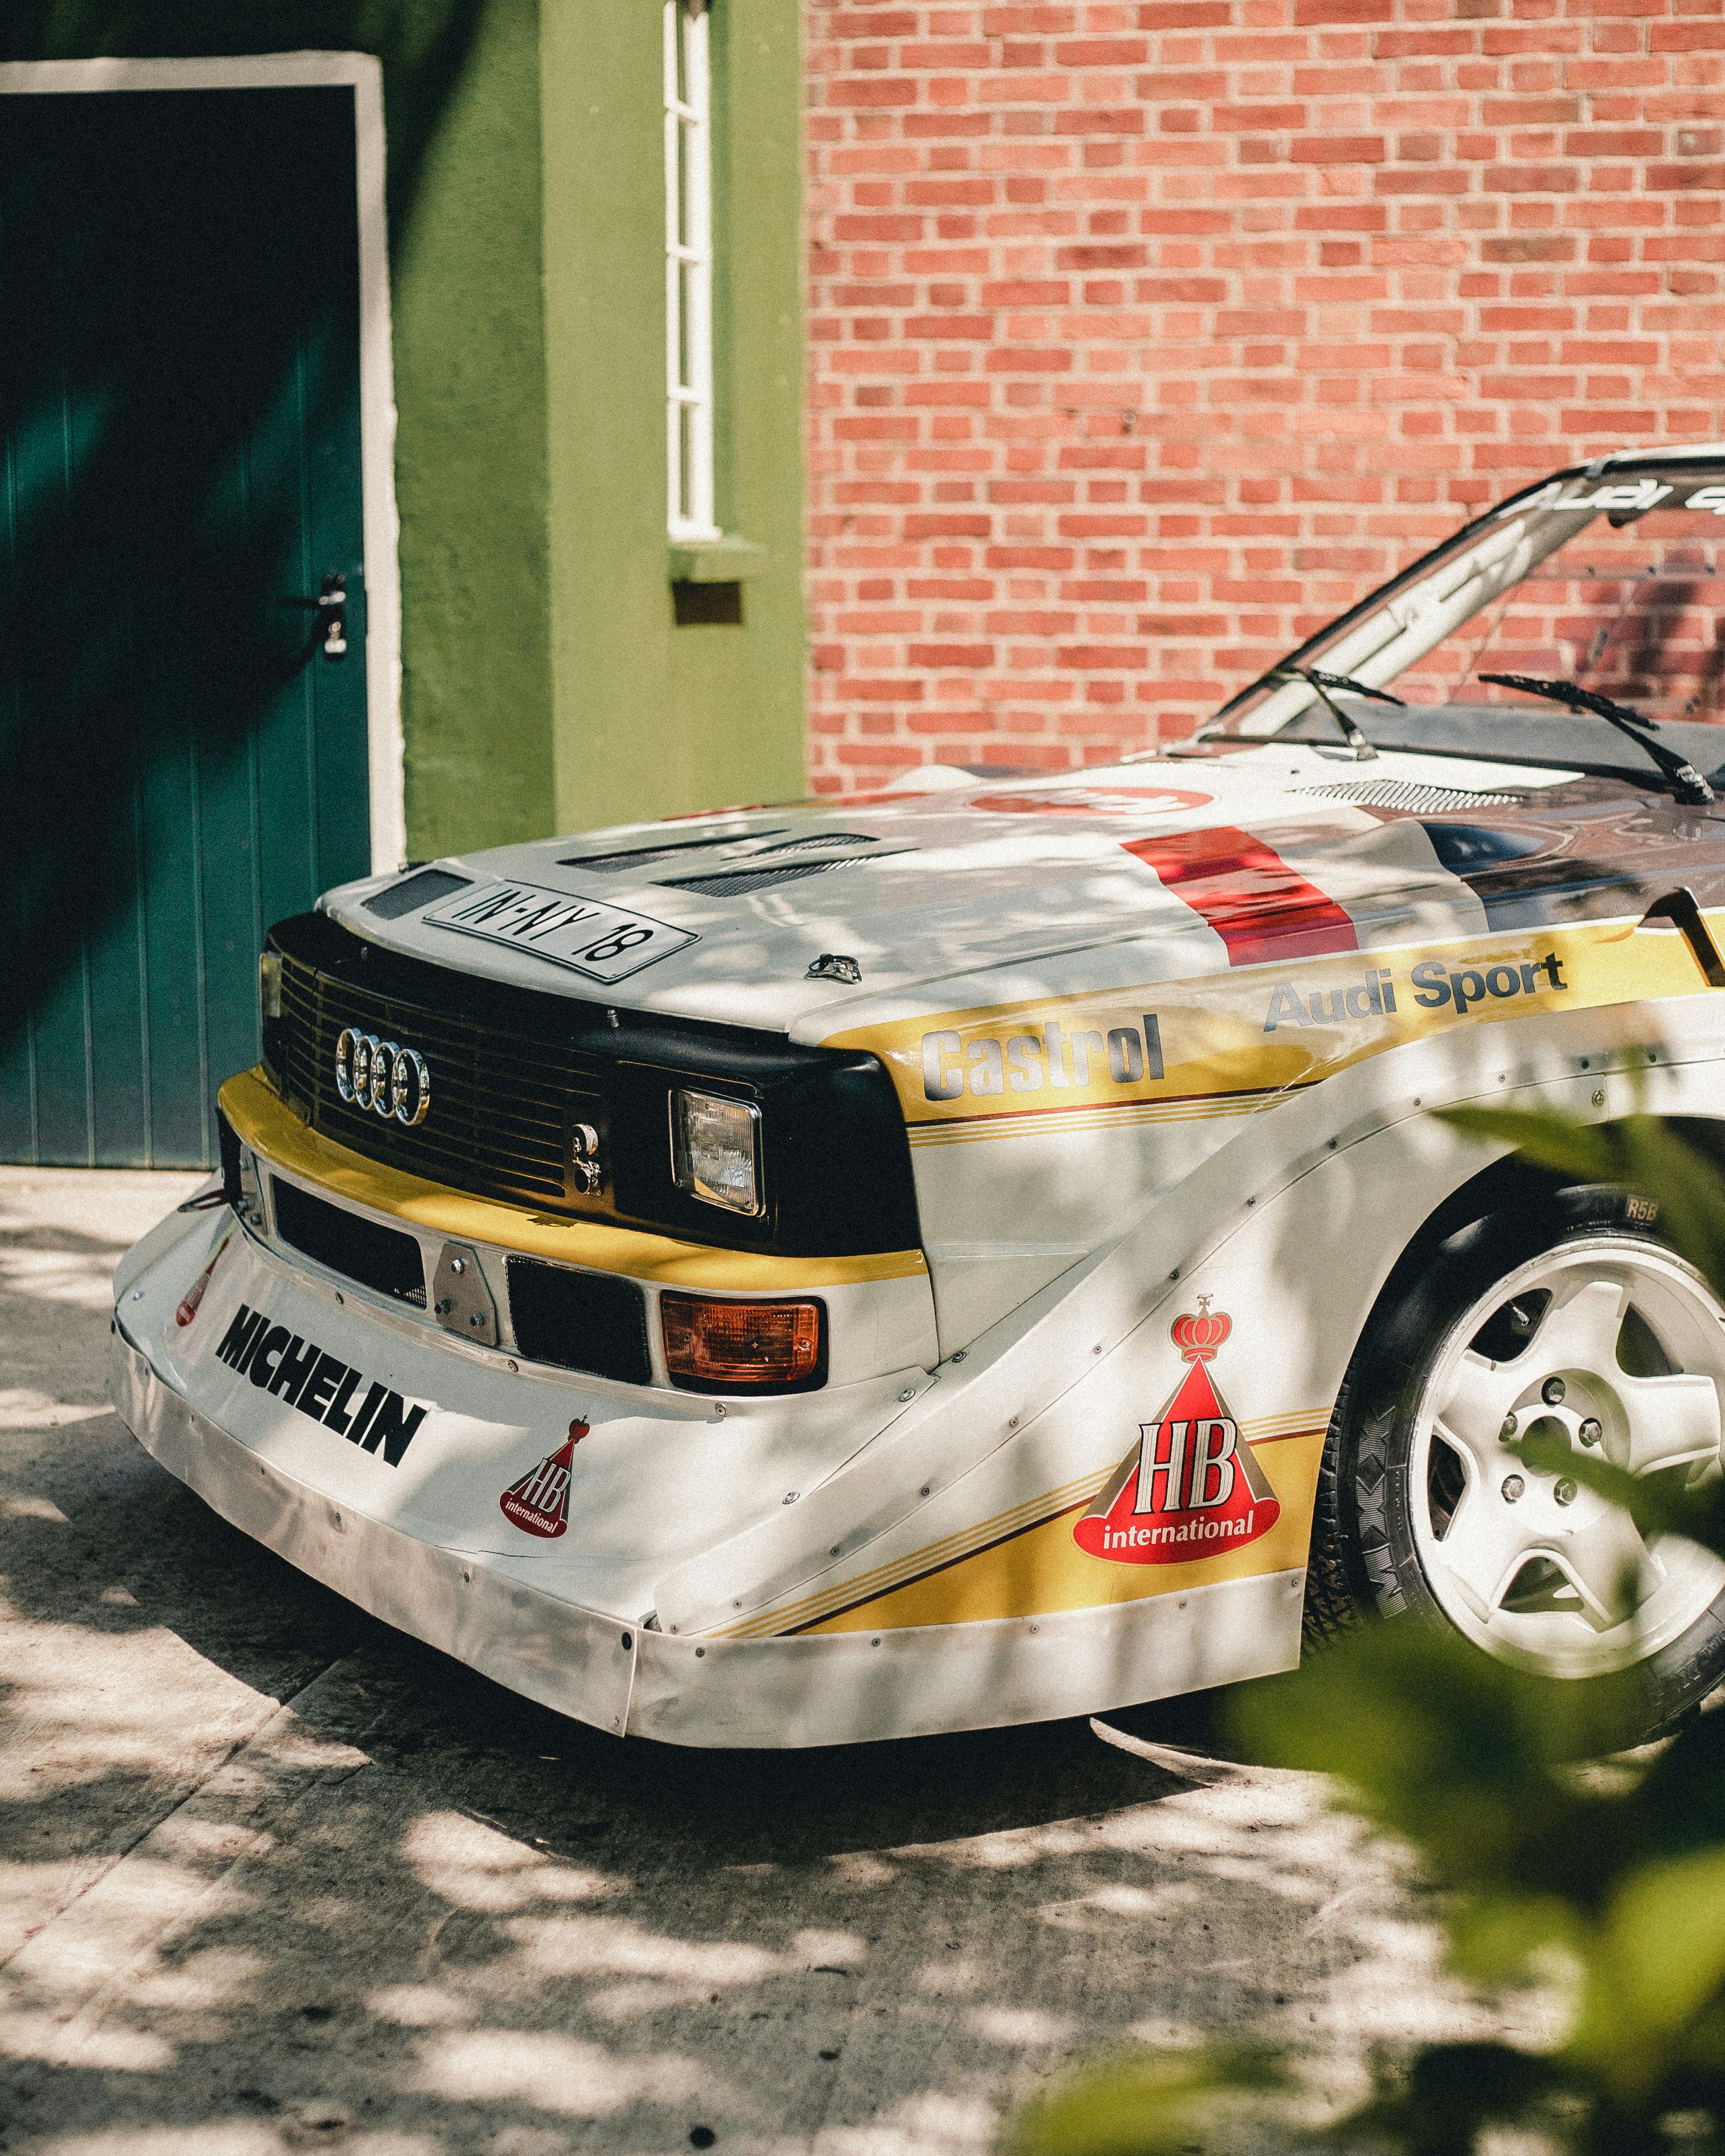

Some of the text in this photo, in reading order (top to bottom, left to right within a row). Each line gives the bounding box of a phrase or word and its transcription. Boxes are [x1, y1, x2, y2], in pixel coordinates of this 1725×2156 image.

[571, 923, 654, 961] 18
[1263, 952, 1568, 1032] Audi Sport
[921, 1013, 1165, 1101] Castrol
[215, 1303, 427, 1468] MICHELIN
[521, 1457, 572, 1513] HB
[1132, 1417, 1238, 1515] HB
[505, 1497, 558, 1534] international
[1103, 1510, 1254, 1550] international
